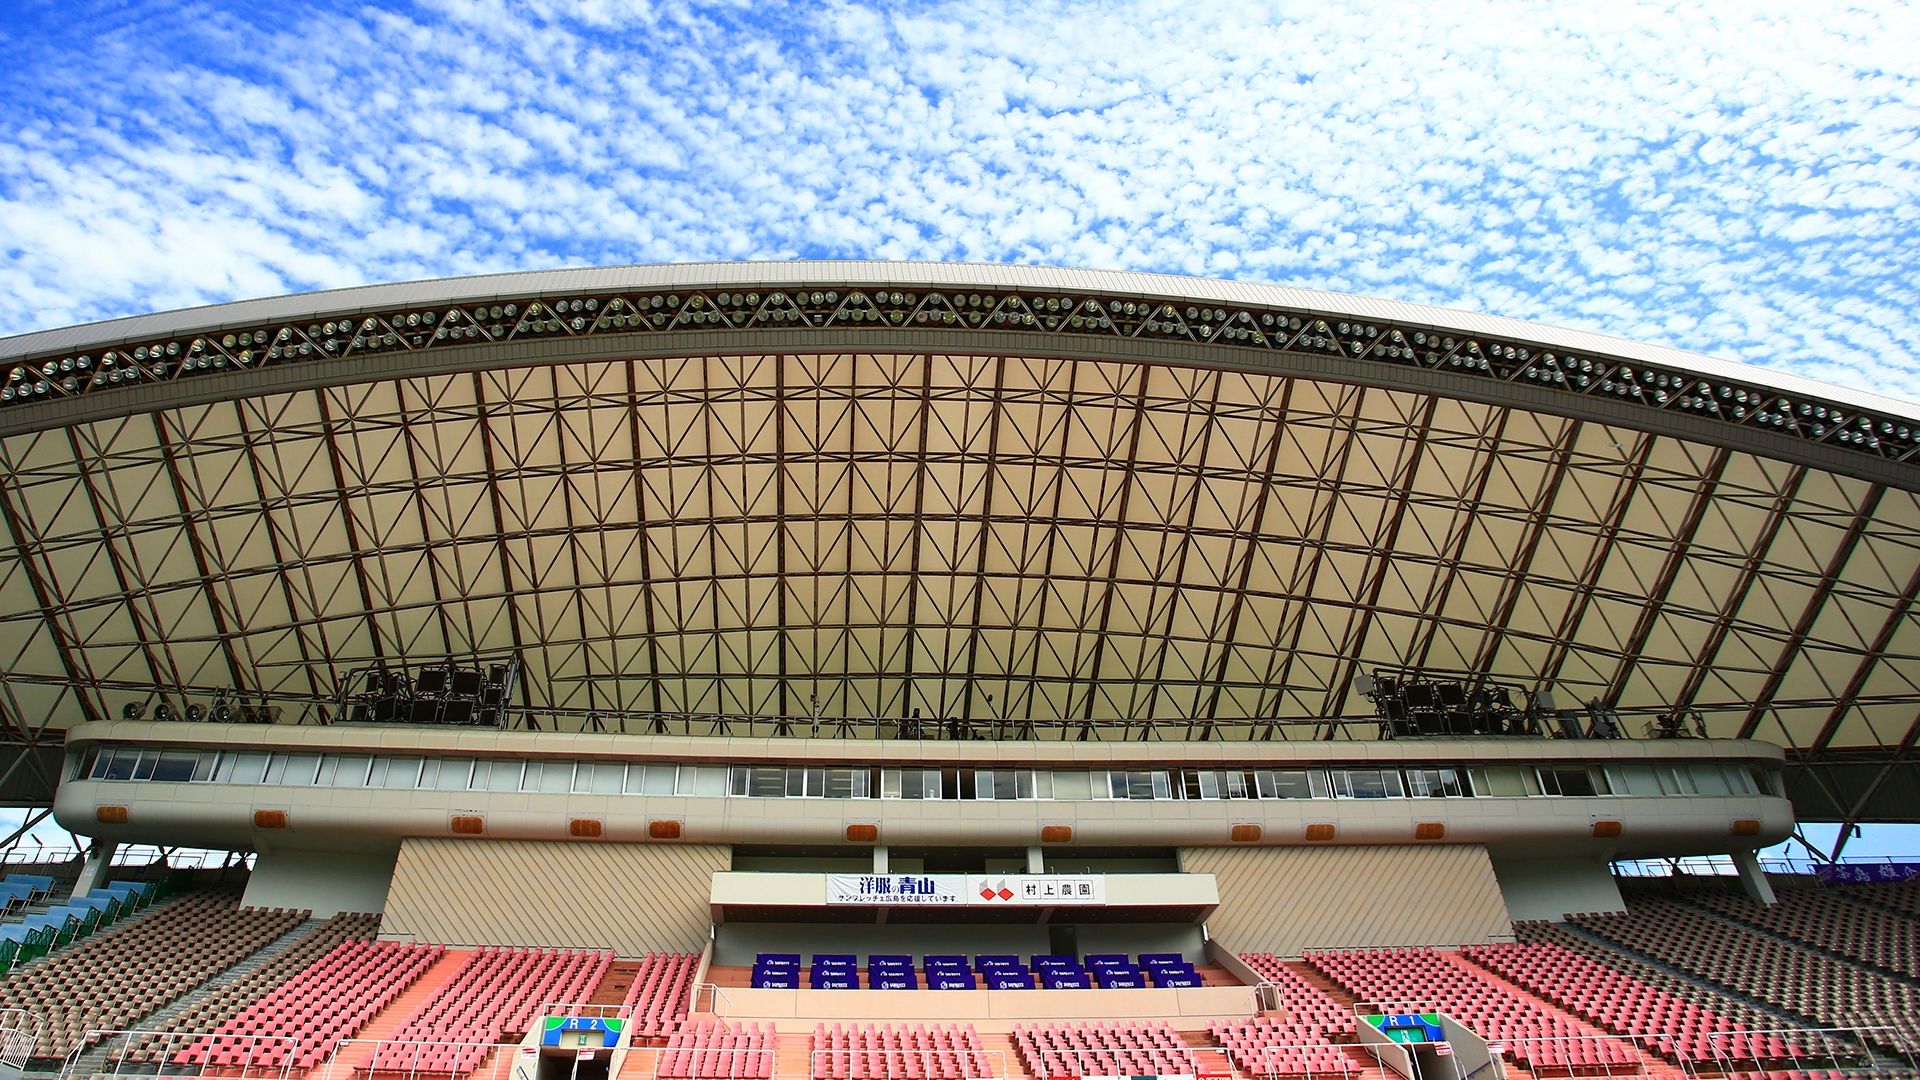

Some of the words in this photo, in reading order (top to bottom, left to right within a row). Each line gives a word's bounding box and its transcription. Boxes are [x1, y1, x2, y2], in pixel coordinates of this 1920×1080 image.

[859, 876, 935, 894] 洋服の青山
[1026, 884, 1090, 895] 村上農園
[569, 1018, 579, 1029] R
[590, 1019, 598, 1030] 2
[1389, 1016, 1399, 1026] R
[1409, 1016, 1416, 1026] 1
